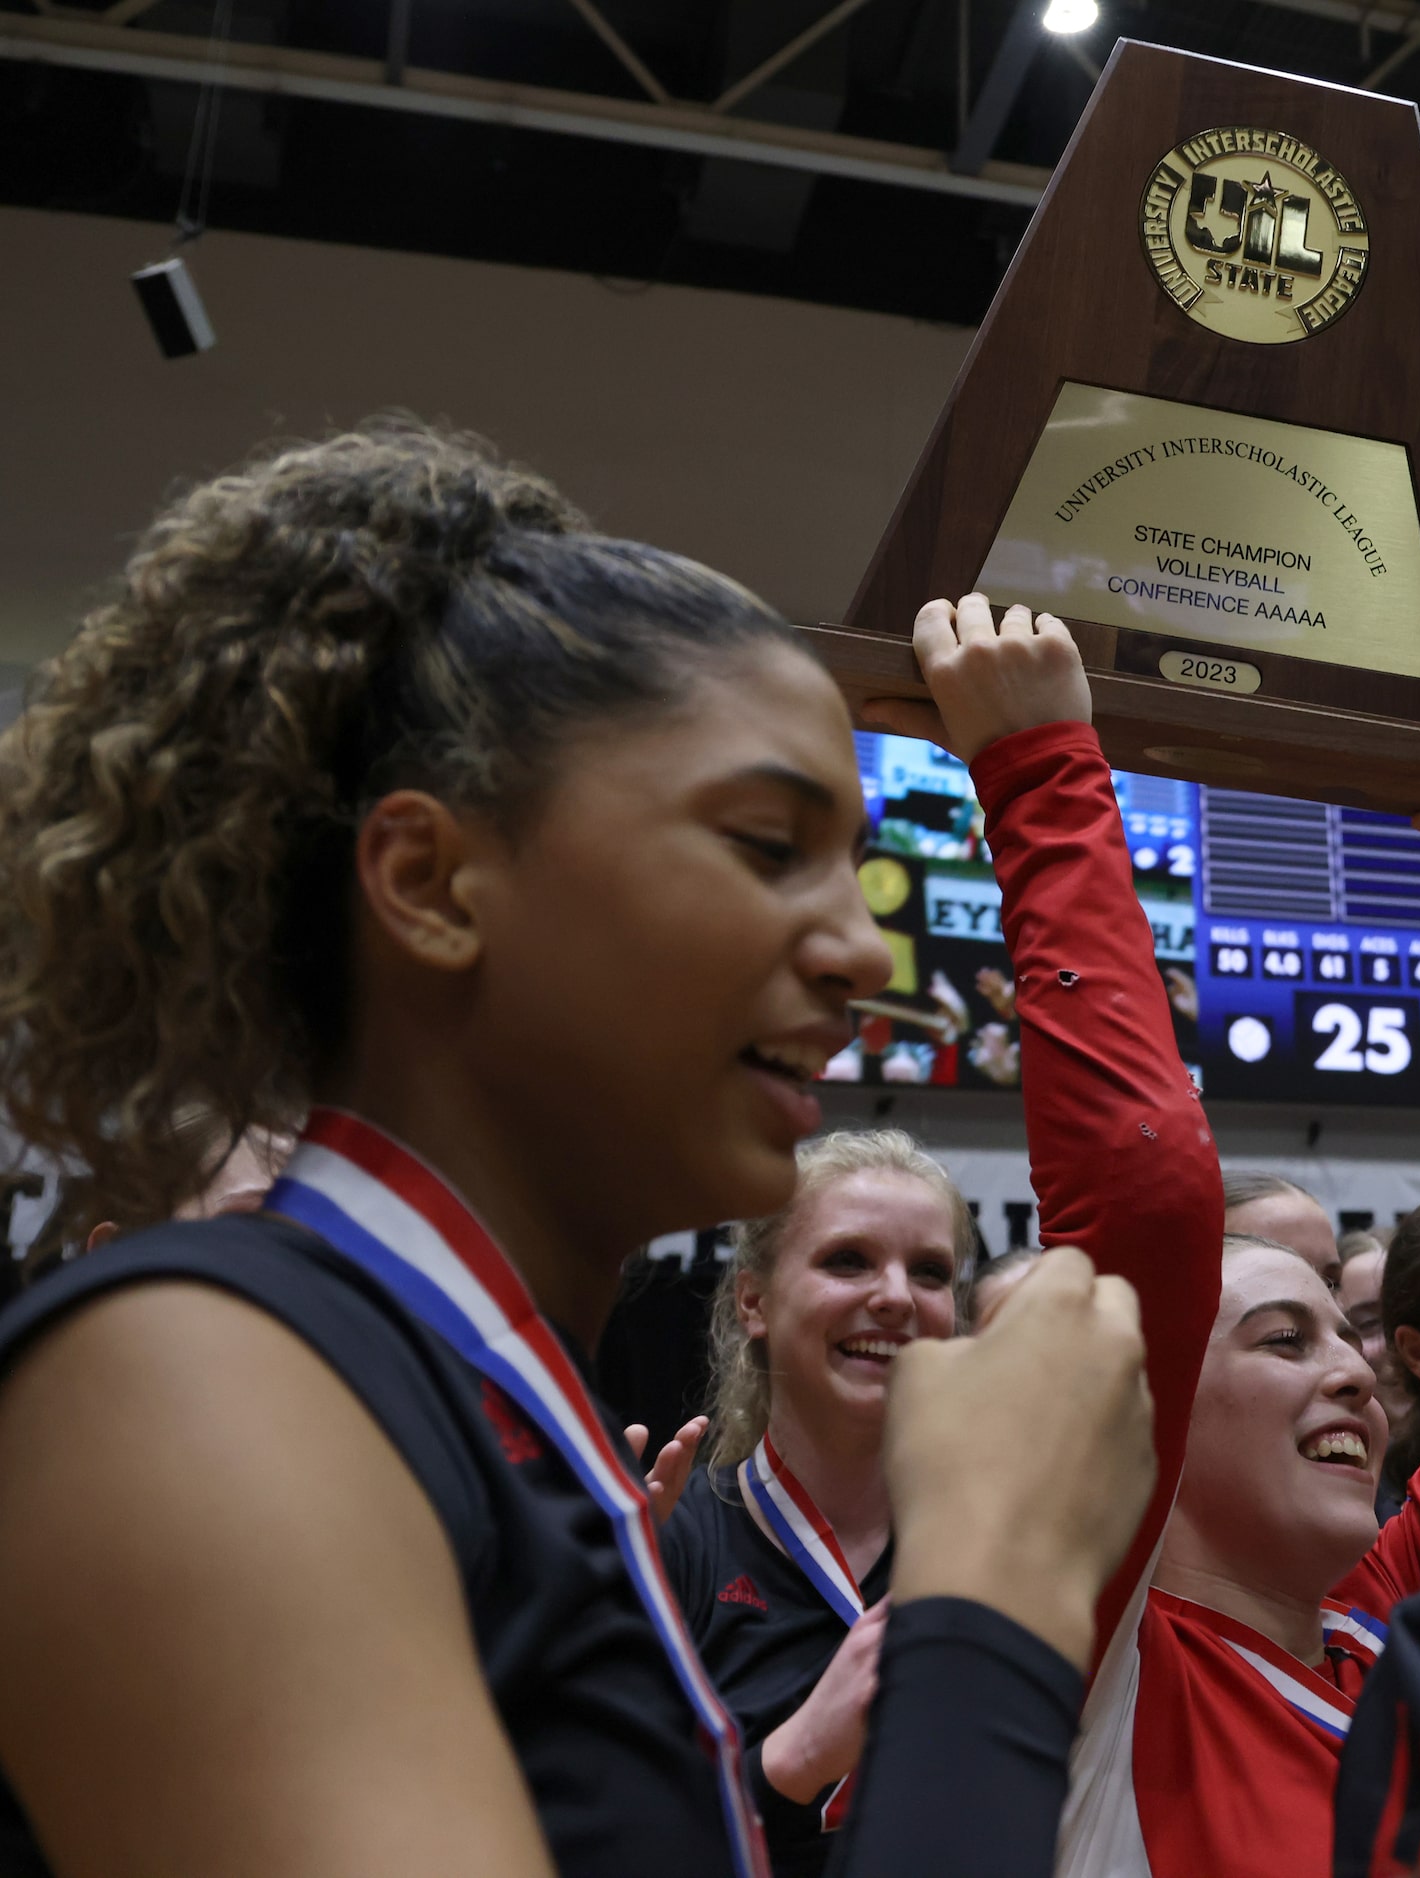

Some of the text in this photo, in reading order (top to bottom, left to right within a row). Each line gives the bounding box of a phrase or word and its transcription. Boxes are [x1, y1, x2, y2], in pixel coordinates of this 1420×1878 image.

[1144, 130, 1366, 330] UNIVERSITY INTERSCHOLASTIC LEAGUE
[1186, 171, 1323, 278] UIL
[1204, 258, 1294, 299] STATE
[1054, 438, 1387, 577] UNIVERSITY INTERSCHOLASTIC LEAGUE
[1134, 525, 1311, 571] STATE CHAMPION
[1156, 556, 1285, 594] VOLLEYBALL
[1108, 576, 1326, 629] CONFERENCE AAAAA
[1180, 658, 1236, 684] 2023
[1312, 1003, 1411, 1075] 25
